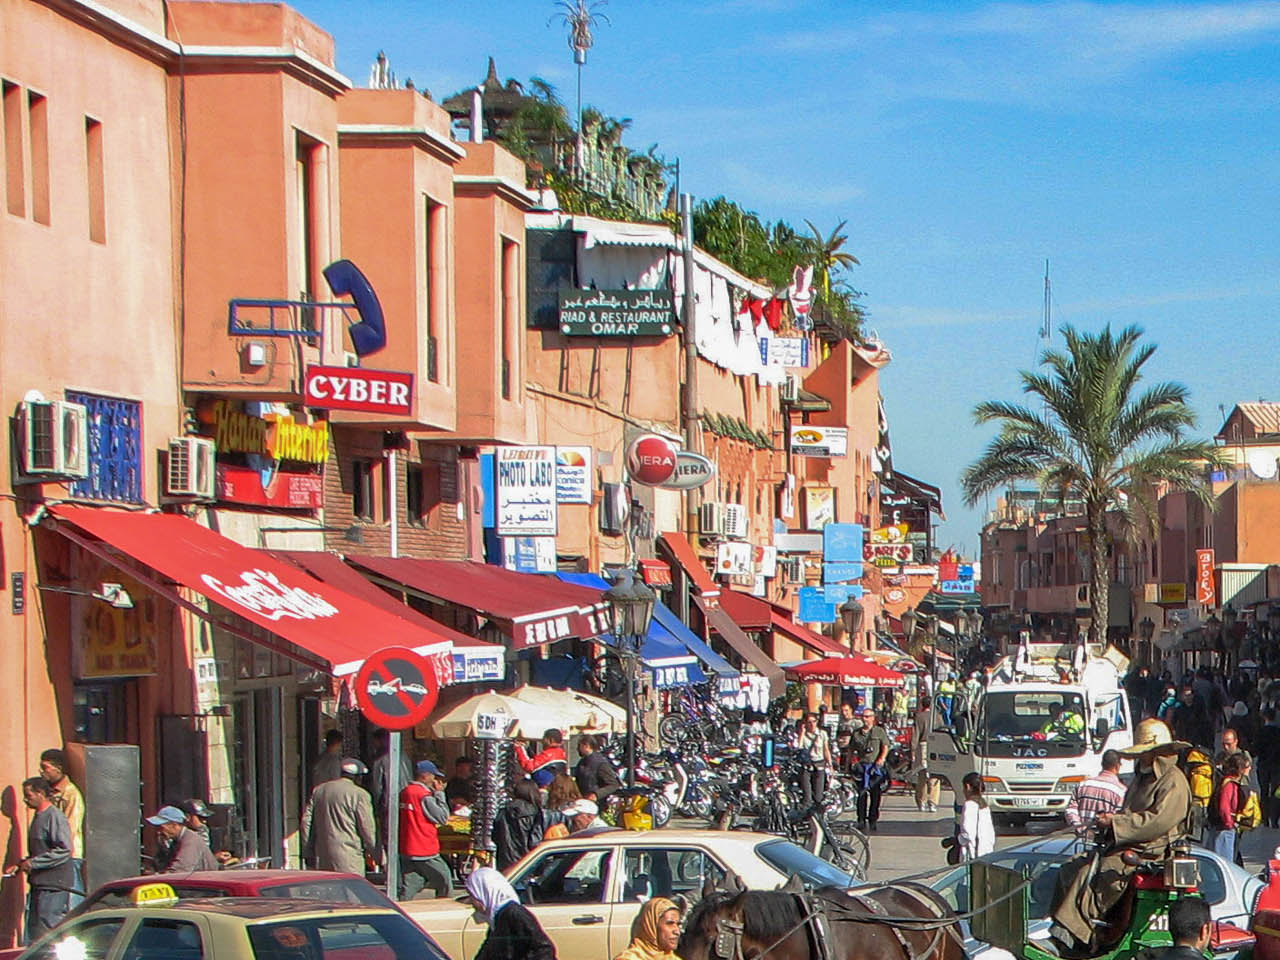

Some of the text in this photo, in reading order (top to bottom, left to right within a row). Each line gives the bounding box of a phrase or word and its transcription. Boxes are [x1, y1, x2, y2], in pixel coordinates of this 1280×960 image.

[560, 311, 671, 323] RIAD & RESTAURANT
[591, 322, 639, 335] OMAR
[308, 374, 409, 406] CYBER
[273, 413, 330, 464] Internet
[499, 461, 553, 487] PHOTO LABO
[501, 491, 550, 508] مختبر
[500, 508, 553, 526] التصوير
[200, 568, 339, 621] Coca-Cola
[485, 714, 496, 731] DH
[1012, 748, 1048, 757] JAC
[141, 887, 170, 899] TAXI
